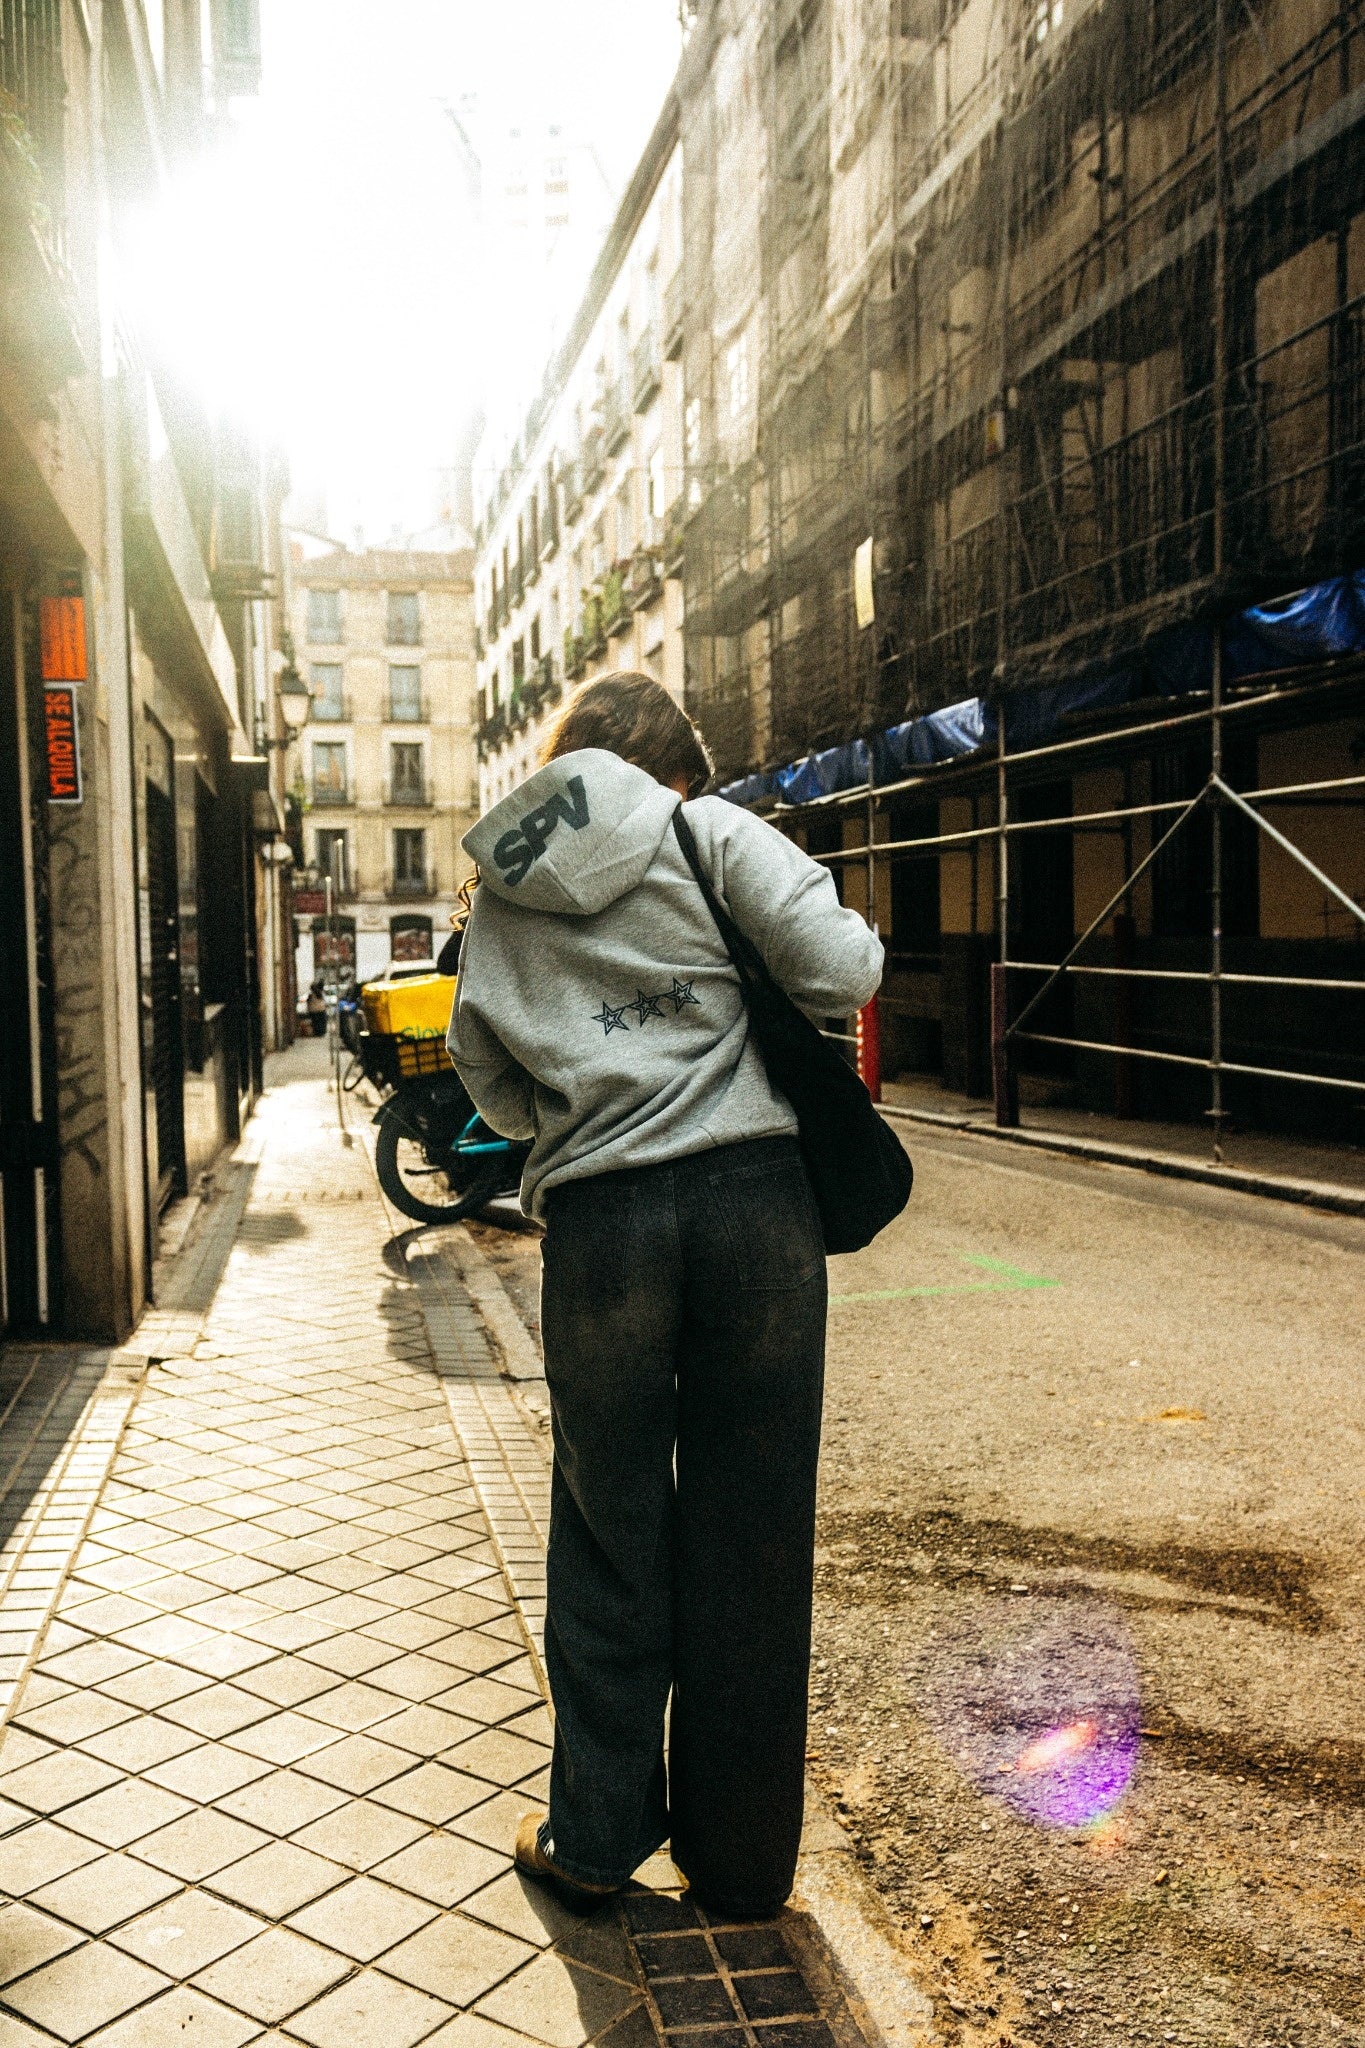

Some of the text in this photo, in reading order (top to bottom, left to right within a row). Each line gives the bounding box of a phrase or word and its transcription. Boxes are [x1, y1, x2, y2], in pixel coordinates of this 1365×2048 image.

[45, 691, 72, 714] SE
[47, 717, 76, 795] ALQUILA
[493, 775, 590, 887] SPV
[402, 1026, 446, 1039] Glov
